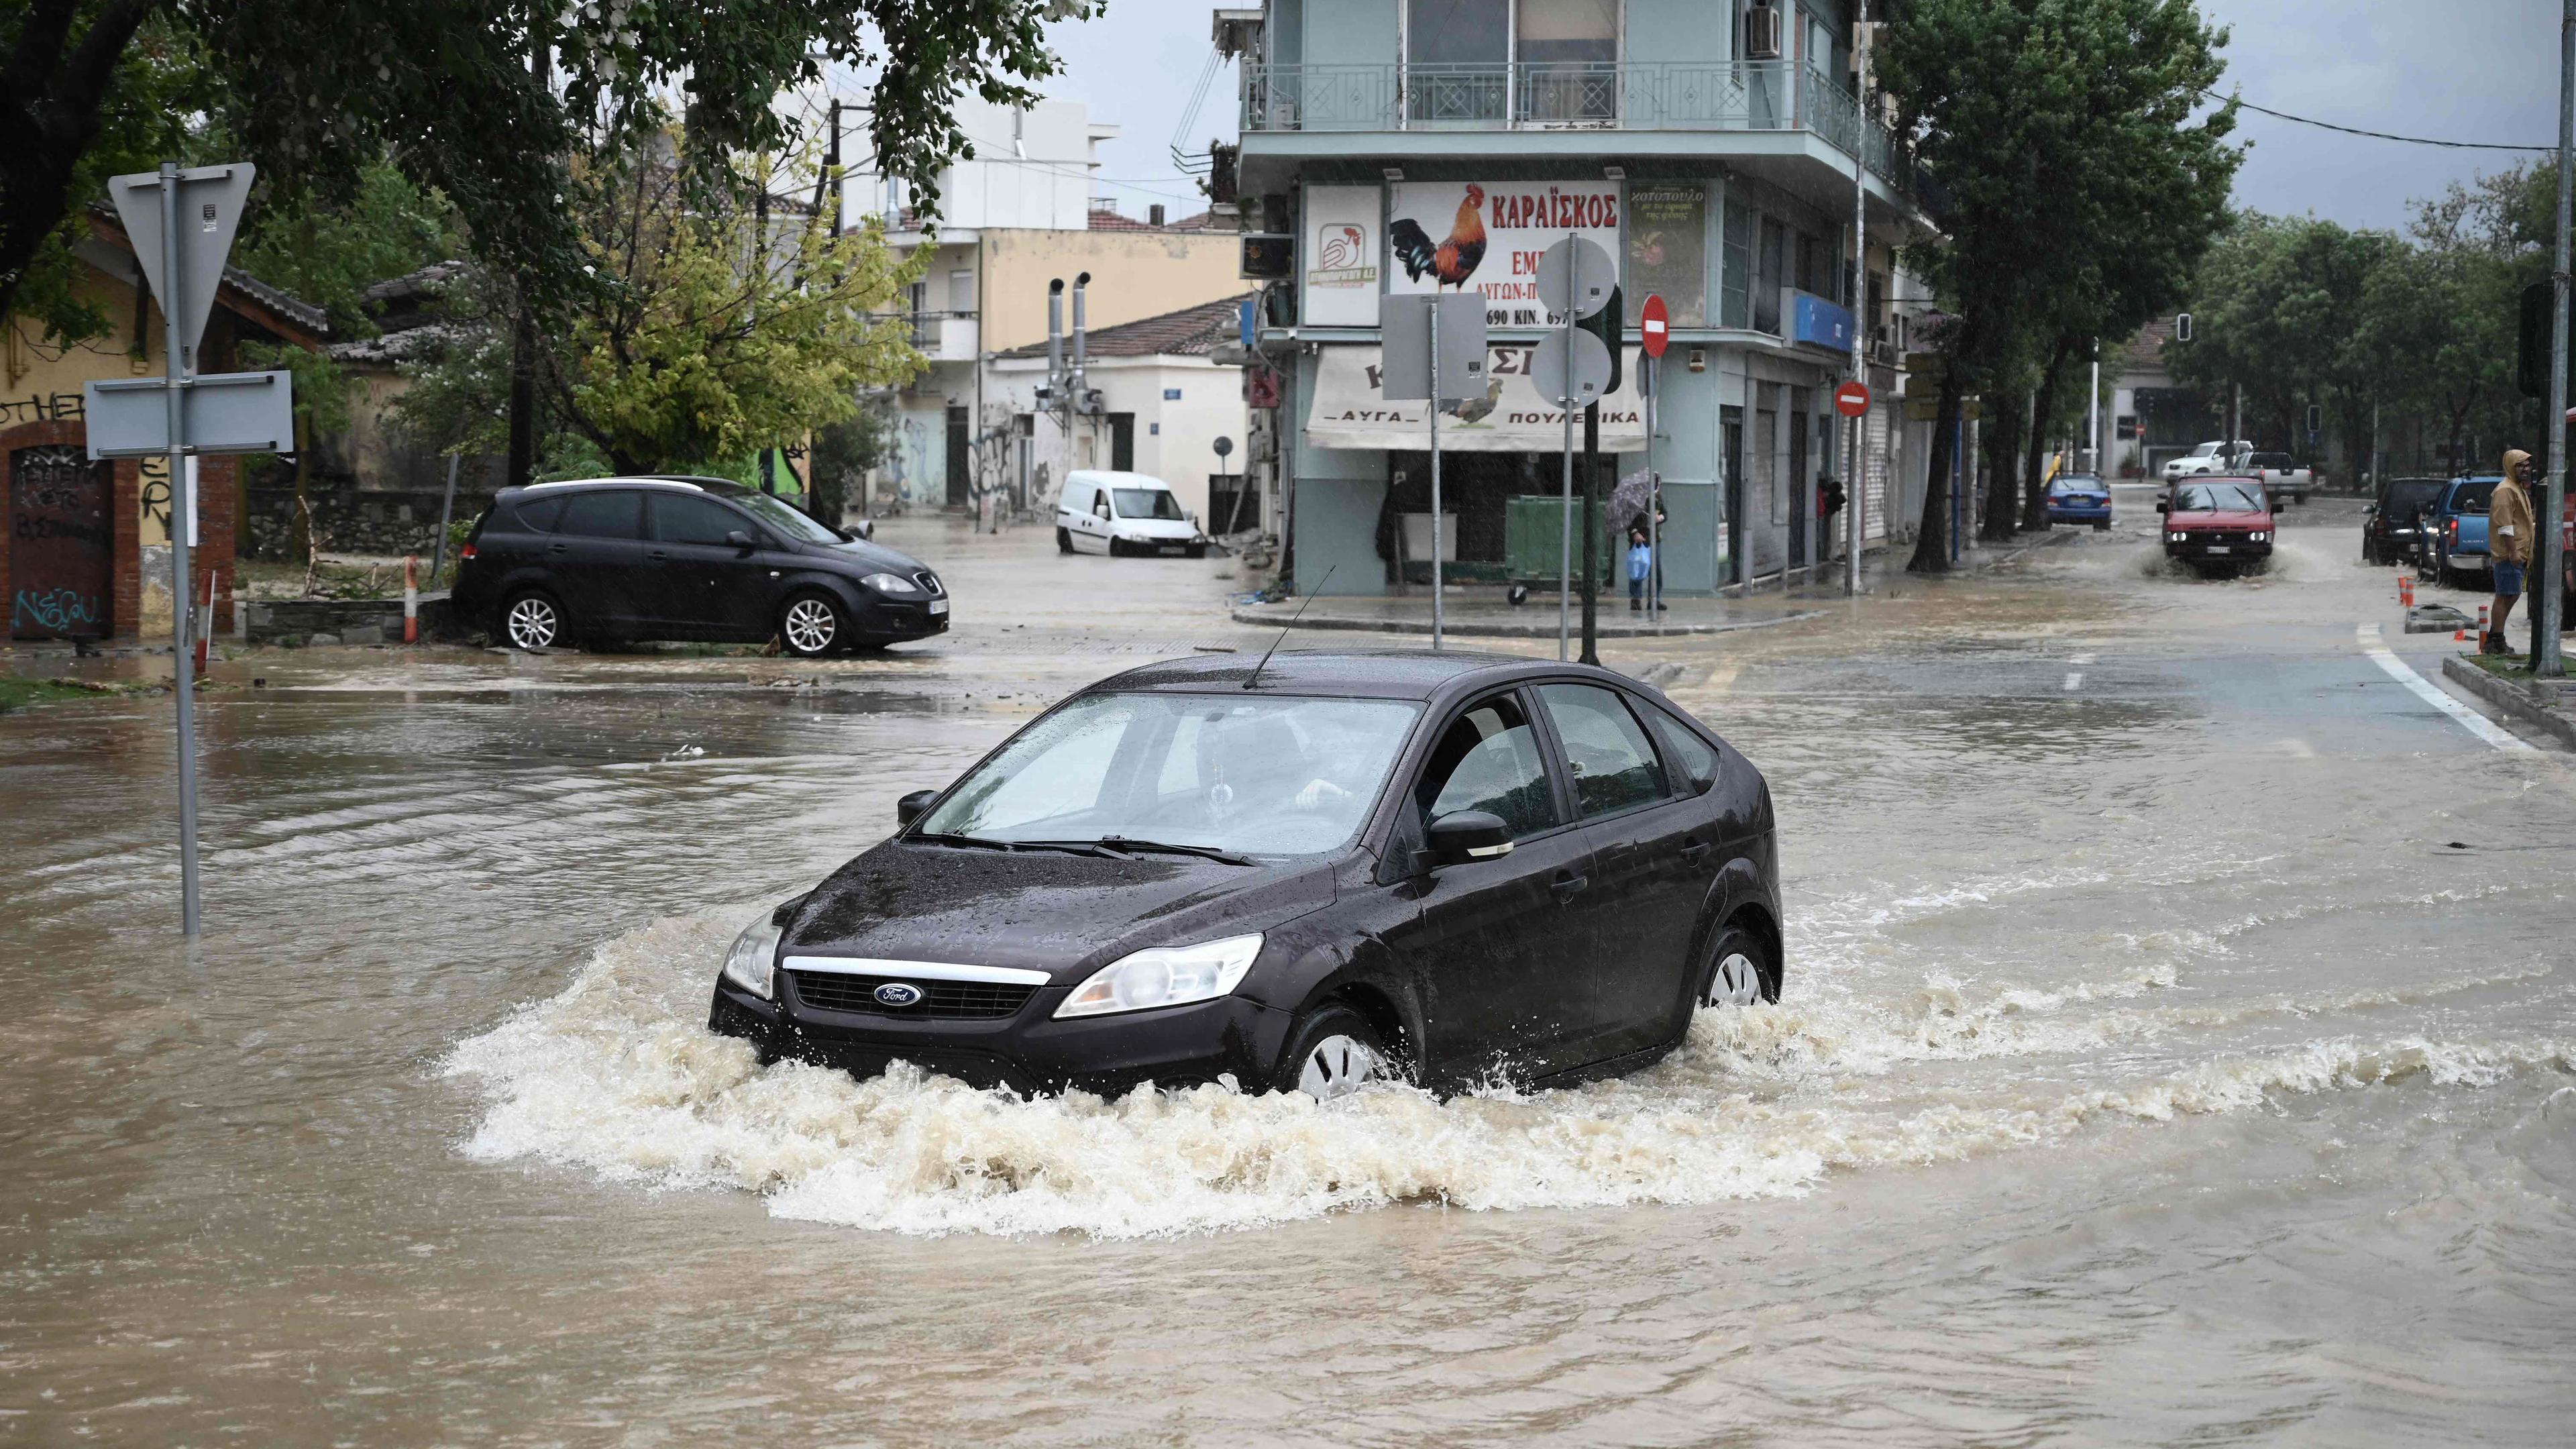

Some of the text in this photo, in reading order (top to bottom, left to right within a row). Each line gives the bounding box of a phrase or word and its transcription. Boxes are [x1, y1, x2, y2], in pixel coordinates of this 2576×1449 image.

[1492, 186, 1617, 228] ΚΑΡΑΪΣΚΟΣ
[1509, 412, 1639, 424] ΠΟΥΛΕΙΚΑ
[883, 987, 908, 1001] Ford
